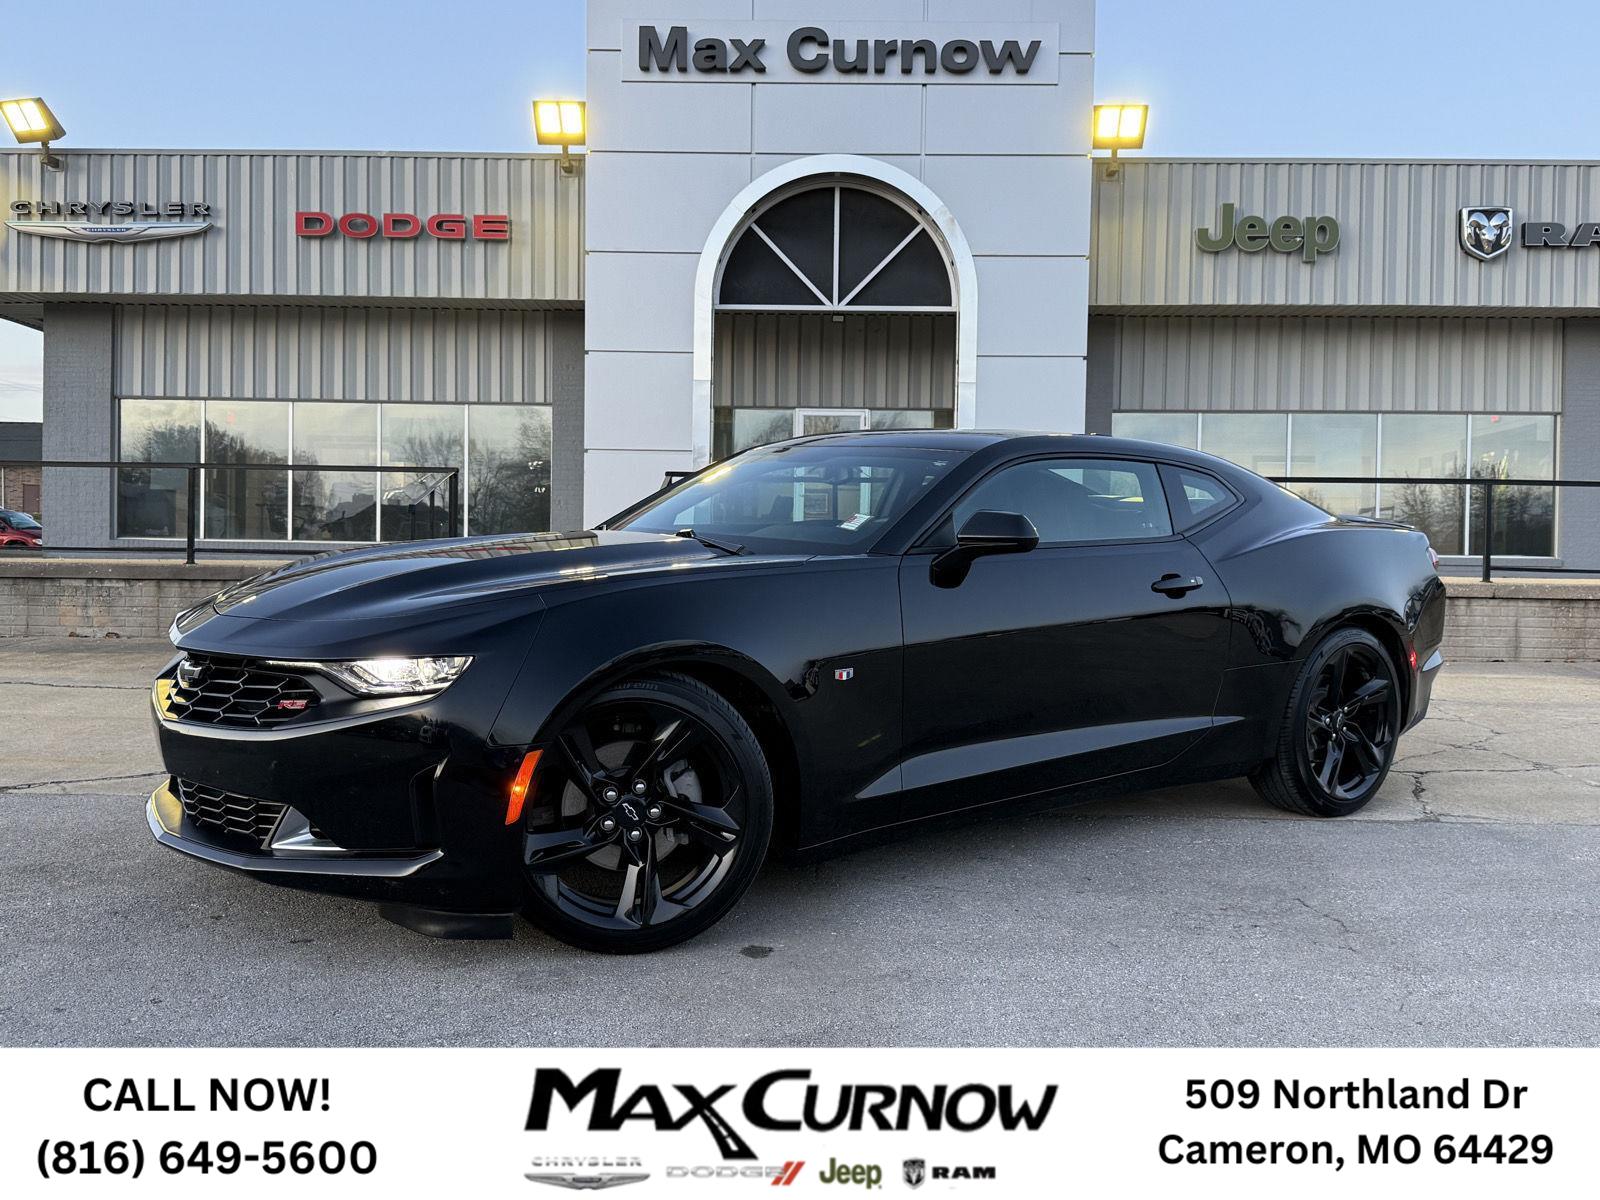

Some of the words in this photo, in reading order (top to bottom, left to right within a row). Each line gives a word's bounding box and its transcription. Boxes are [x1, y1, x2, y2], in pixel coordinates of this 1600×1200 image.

[638, 25, 767, 73] Max
[786, 26, 1043, 75] Curnow
[9, 199, 211, 216] CHRYSLER
[294, 210, 510, 241] DODGE
[1195, 202, 1341, 264] Jeep
